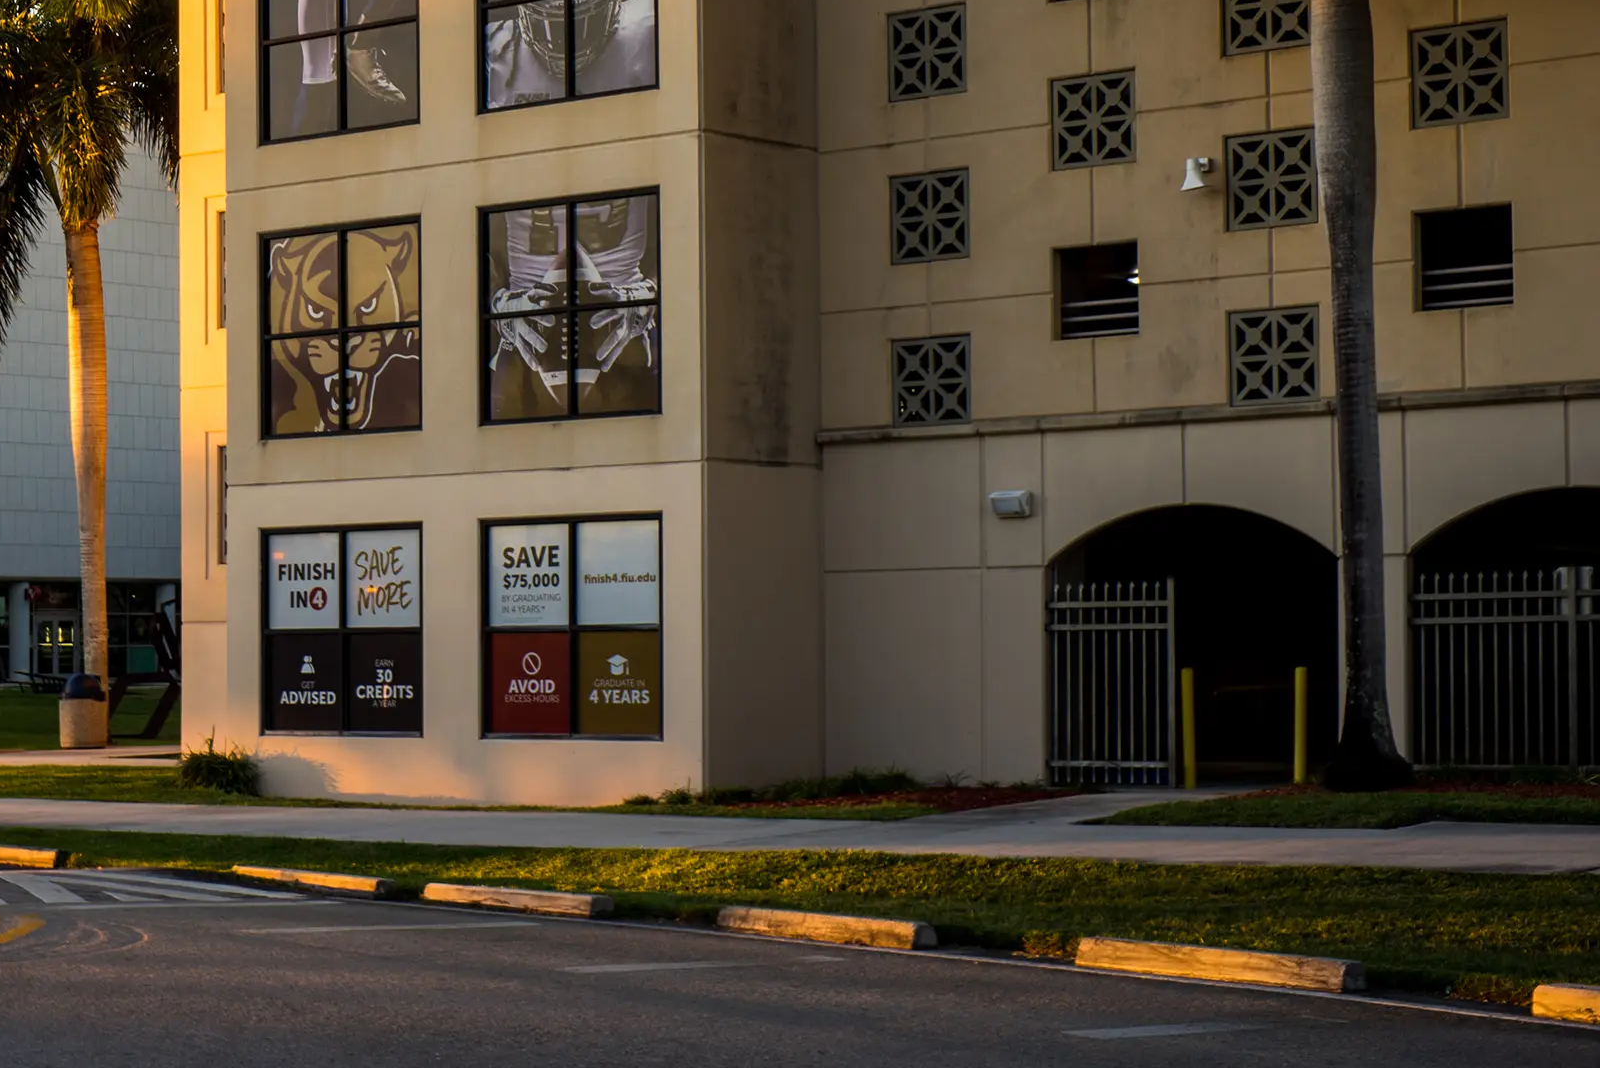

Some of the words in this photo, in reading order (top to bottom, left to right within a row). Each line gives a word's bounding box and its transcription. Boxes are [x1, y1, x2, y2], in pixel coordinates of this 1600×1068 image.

[354, 546, 403, 580] SAVE
[502, 545, 560, 569] SAVE
[278, 562, 335, 581] FINISH
[584, 572, 656, 584] finish4.fiu.edu
[503, 573, 560, 590] $75,000
[357, 580, 413, 616] MORE
[501, 594, 511, 603] BY
[512, 593, 561, 603] GRADUATING
[375, 659, 394, 667] EARN
[376, 669, 393, 683] 30
[594, 678, 635, 688] GRADUATE
[637, 679, 645, 687] IN
[301, 681, 315, 690] GET
[356, 684, 414, 699] CREDITS
[509, 679, 555, 693] AVOID
[280, 691, 336, 705] ADVISED
[379, 699, 397, 708] YEAR
[504, 694, 532, 703] EXCESS
[533, 694, 560, 703] HOURS
[589, 690, 599, 704] 4
[602, 689, 650, 704] YEARS
